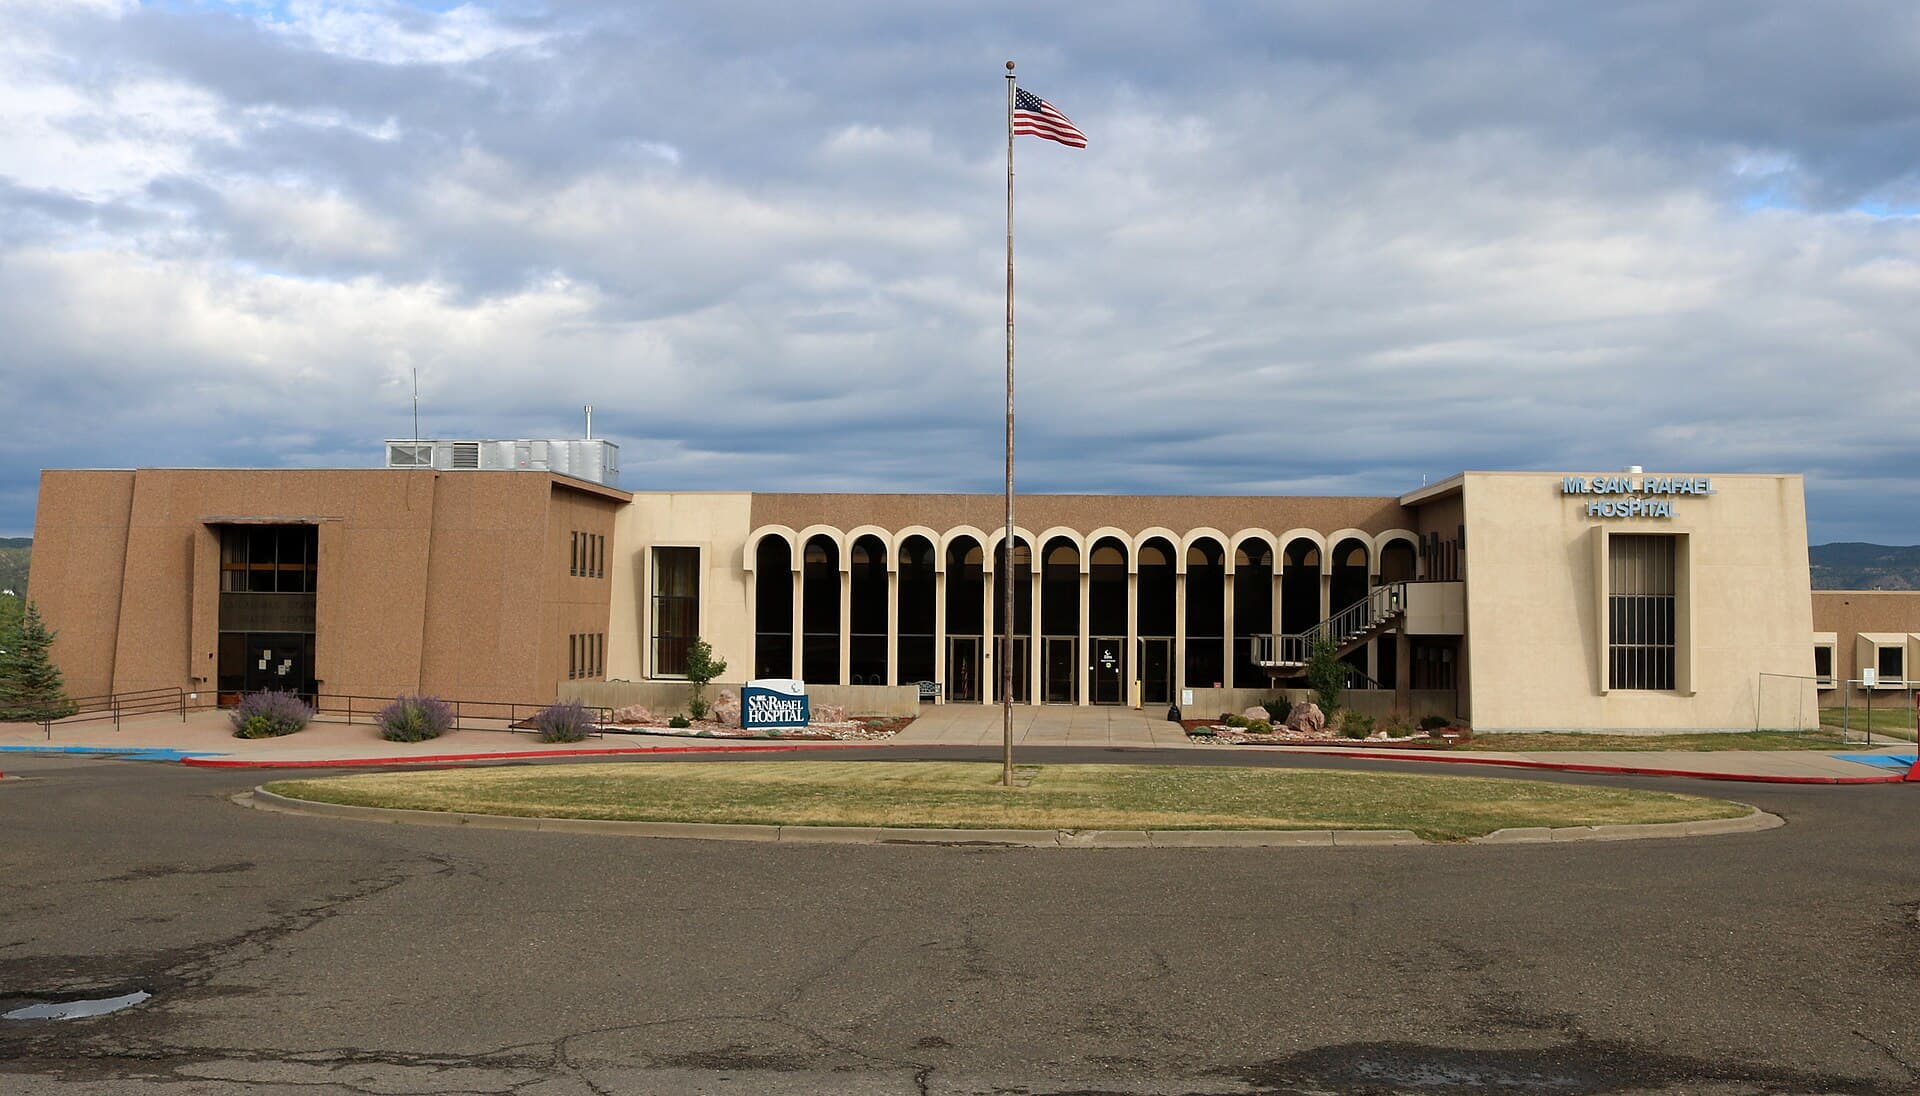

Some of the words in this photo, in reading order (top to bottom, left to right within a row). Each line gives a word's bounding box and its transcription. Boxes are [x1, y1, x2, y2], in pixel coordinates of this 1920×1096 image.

[1592, 477, 1633, 494] SAN
[1643, 477, 1717, 494] RAFAEL
[1587, 499, 1680, 518] HOSPITAL
[748, 710, 805, 723] HOSPITAL
